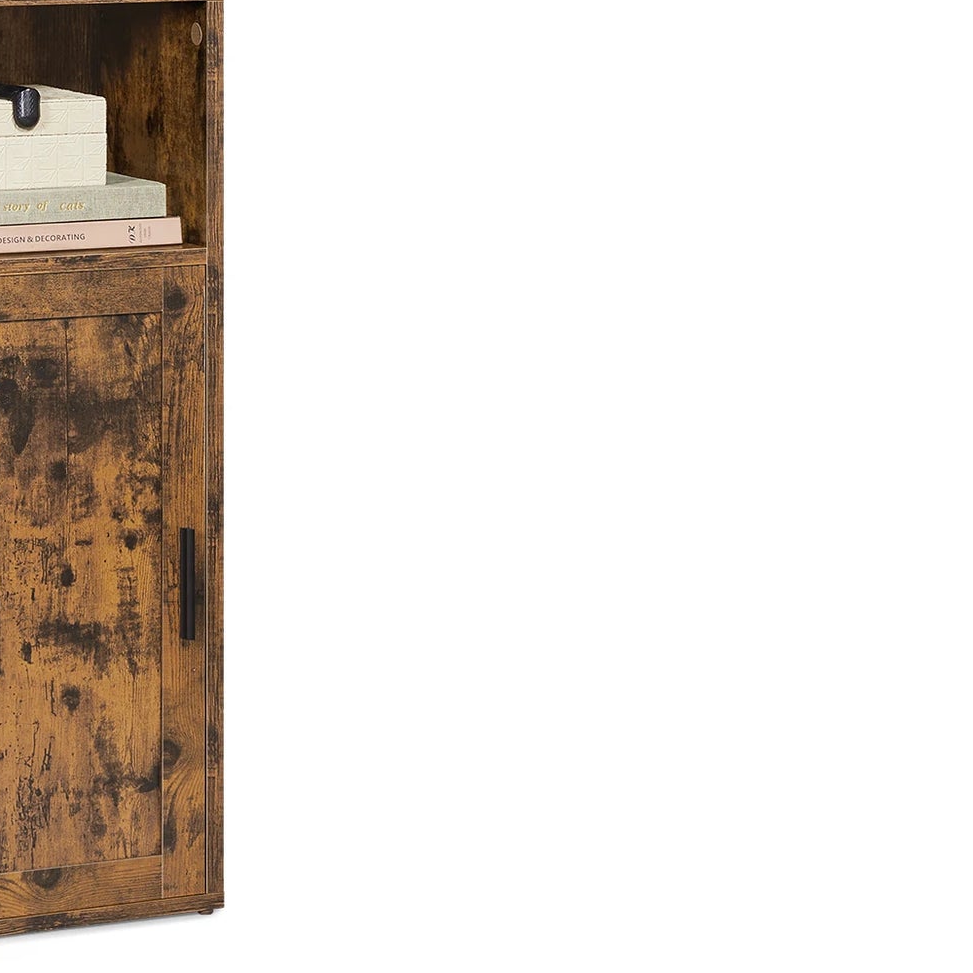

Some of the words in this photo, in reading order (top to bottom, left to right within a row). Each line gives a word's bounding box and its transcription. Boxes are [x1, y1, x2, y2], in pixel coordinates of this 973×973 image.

[3, 201, 30, 213] story
[37, 200, 49, 212] of
[60, 200, 86, 212] cats
[35, 233, 86, 243] DECORATING
